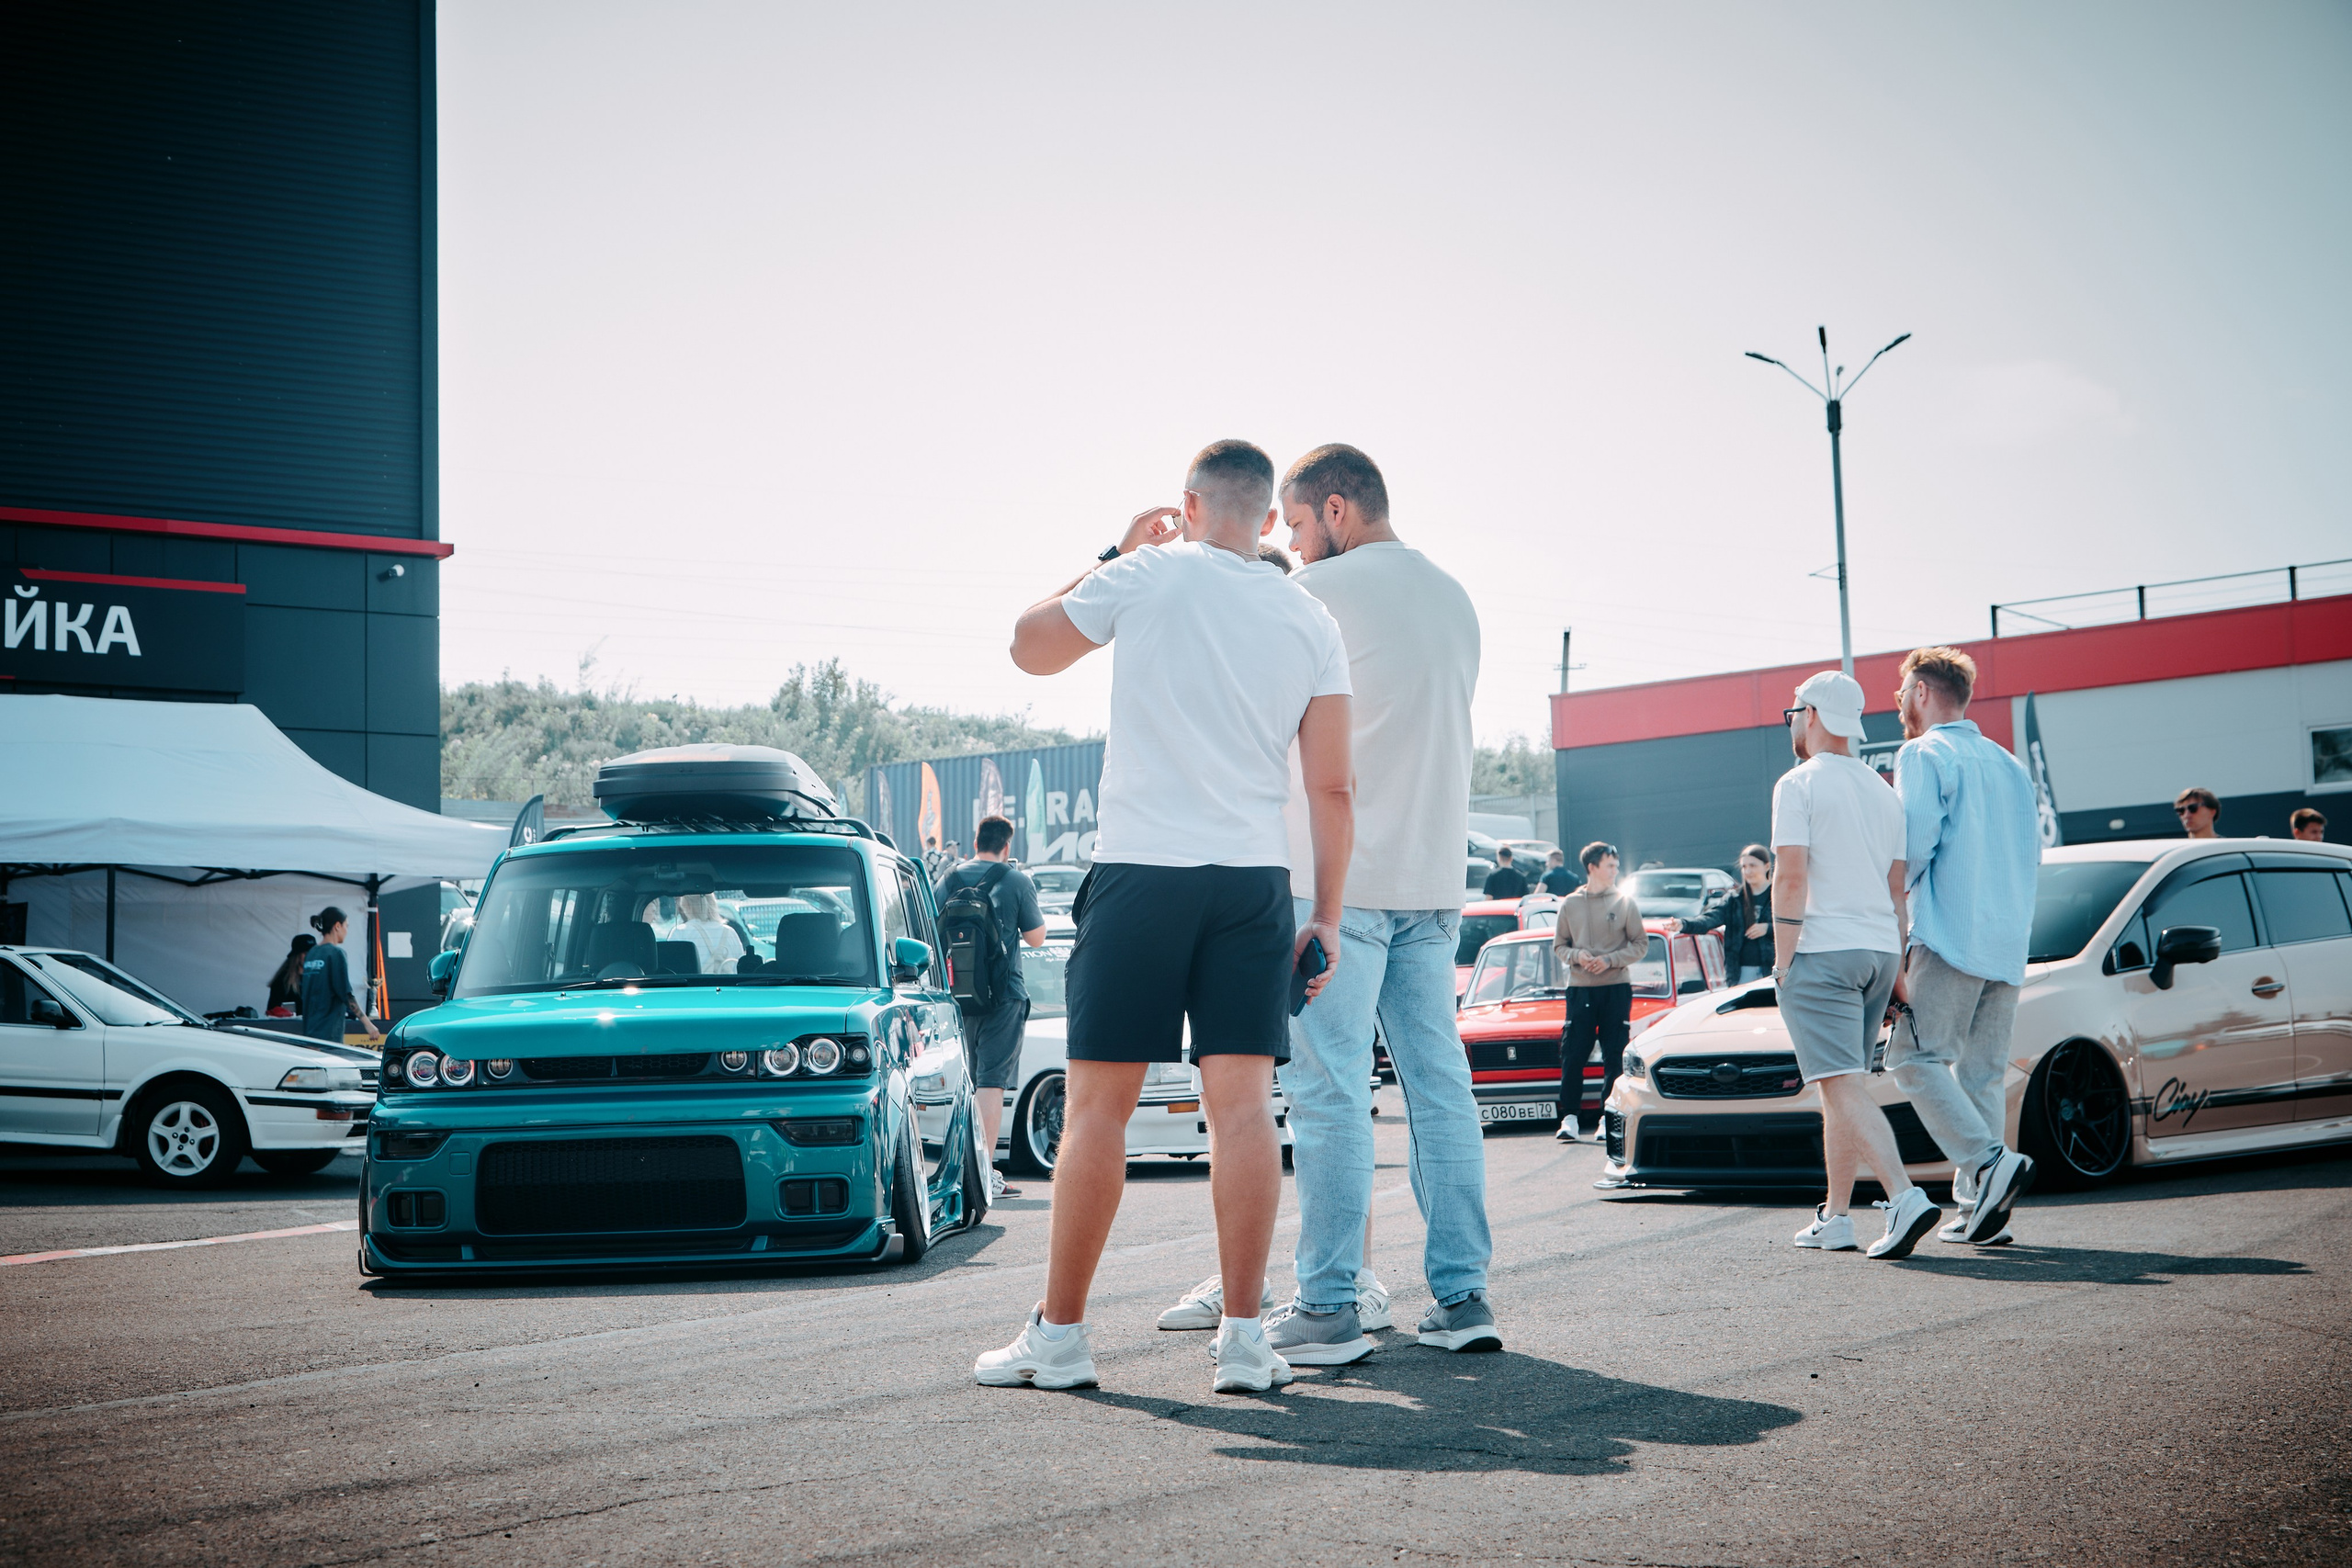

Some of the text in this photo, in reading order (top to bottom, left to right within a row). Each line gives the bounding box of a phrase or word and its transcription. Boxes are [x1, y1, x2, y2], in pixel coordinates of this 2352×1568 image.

[5, 584, 141, 657] ЙКА
[1021, 950, 1054, 959] TION
[1539, 1103, 1552, 1113] 70
